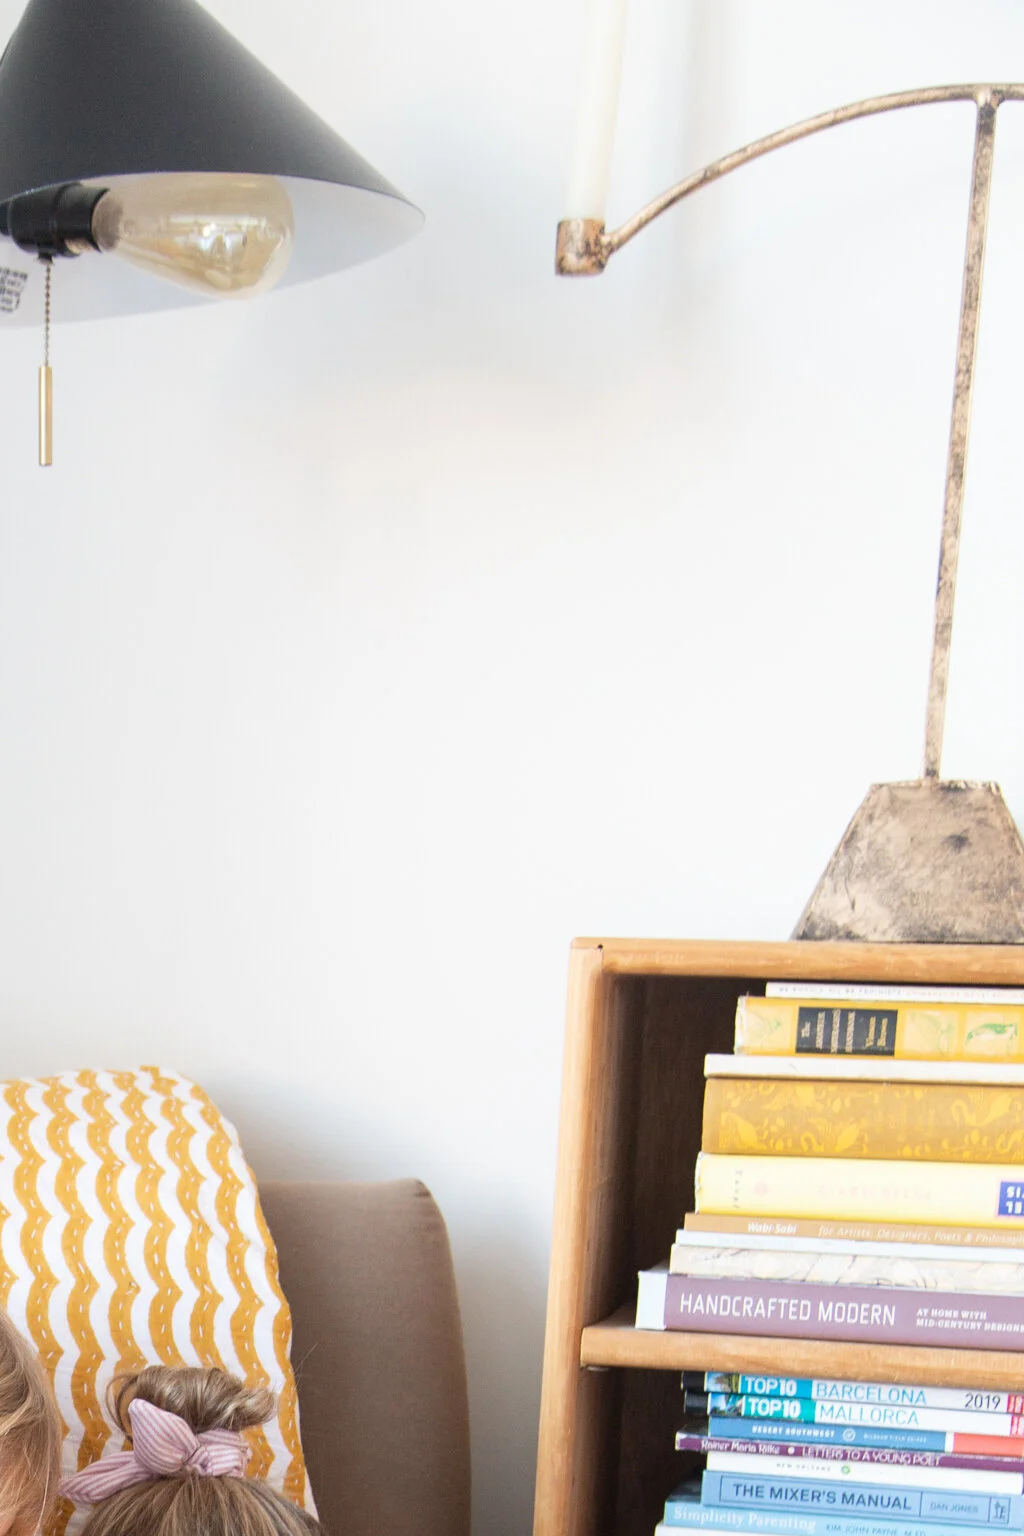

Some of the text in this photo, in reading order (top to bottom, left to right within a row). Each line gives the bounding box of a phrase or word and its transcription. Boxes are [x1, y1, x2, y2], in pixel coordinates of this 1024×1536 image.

[680, 1293, 896, 1326] HANDCRAFTED MODERN
[916, 1307, 987, 1319] AT HOME WITH
[916, 1318, 1024, 1333] MID-CENTURY DESIGNE
[816, 1381, 927, 1405] BARCELONA
[964, 1393, 1001, 1410] 2019
[819, 1406, 919, 1425] MALLORCA
[785, 1427, 836, 1438] SOUTHWEST
[701, 1440, 728, 1452] Rainer
[730, 1441, 757, 1453] Maria
[846, 1449, 862, 1460] TO
[863, 1450, 872, 1460] A
[872, 1450, 912, 1465] YOUNG
[913, 1455, 940, 1466] POET
[733, 1483, 913, 1510] THE MIXER'S MANUAL
[930, 1502, 979, 1514] DAN JONES
[674, 1507, 817, 1535] Simplicity Parenting
[826, 1523, 842, 1532] KIM
[844, 1525, 869, 1535] JOHN
